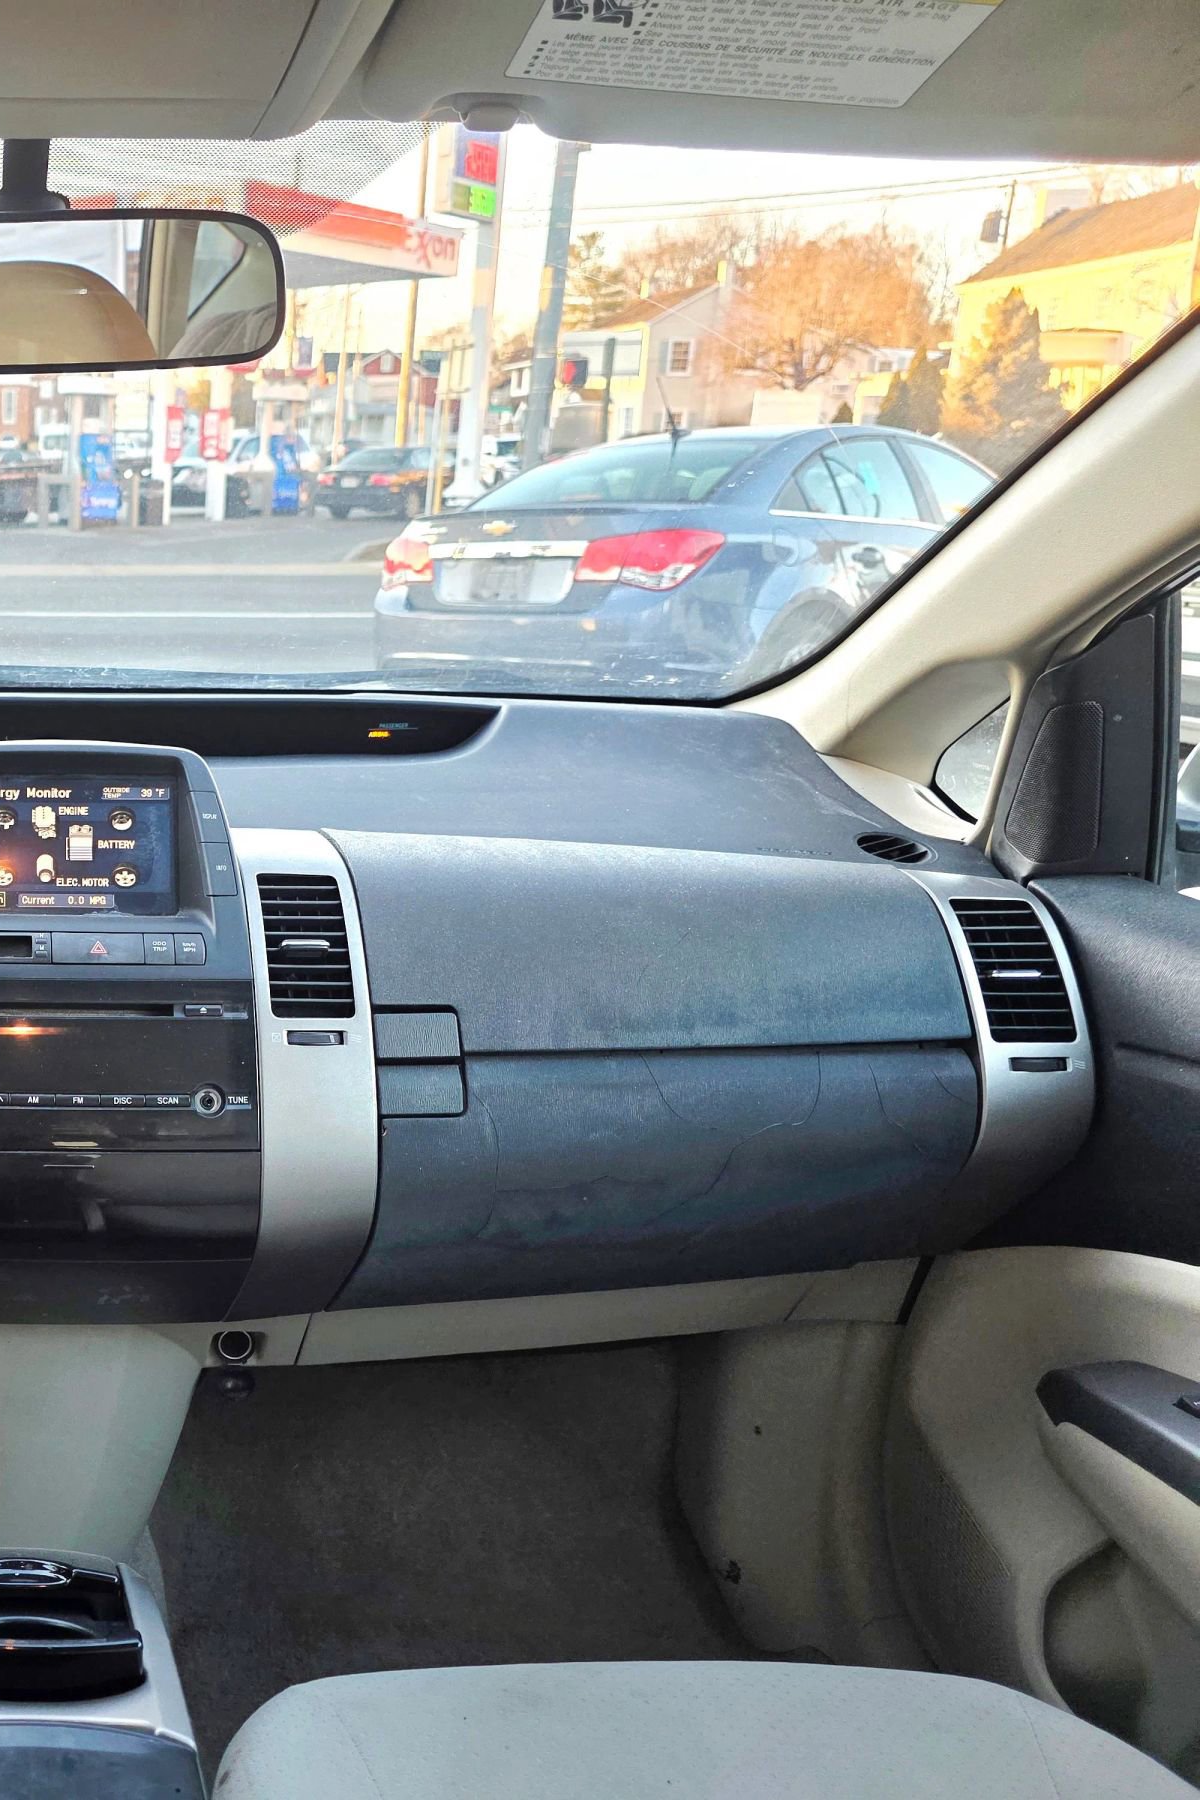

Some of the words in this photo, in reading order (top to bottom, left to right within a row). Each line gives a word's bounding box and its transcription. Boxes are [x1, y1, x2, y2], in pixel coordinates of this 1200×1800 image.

[913, 0, 961, 11] BAGS
[564, 32, 597, 42] MÊME
[600, 36, 630, 45] AVEC
[632, 38, 656, 47] DES
[658, 39, 712, 51] COUSSINS
[714, 43, 731, 52] DE
[789, 49, 807, 58] DE
[808, 50, 865, 62] NOUVELLE
[26, 787, 72, 799] Monitor
[140, 788, 152, 798] 39
[58, 806, 89, 816] ENGINE
[97, 840, 136, 850] BATTERY
[21, 895, 56, 905] Current
[67, 895, 86, 905] 0.0
[89, 895, 107, 905] MPG
[27, 1096, 40, 1105] AM
[72, 1096, 85, 1105] FM
[113, 1096, 133, 1105] DISC
[157, 1096, 180, 1105] SCAN
[227, 1096, 250, 1105] TUNE
